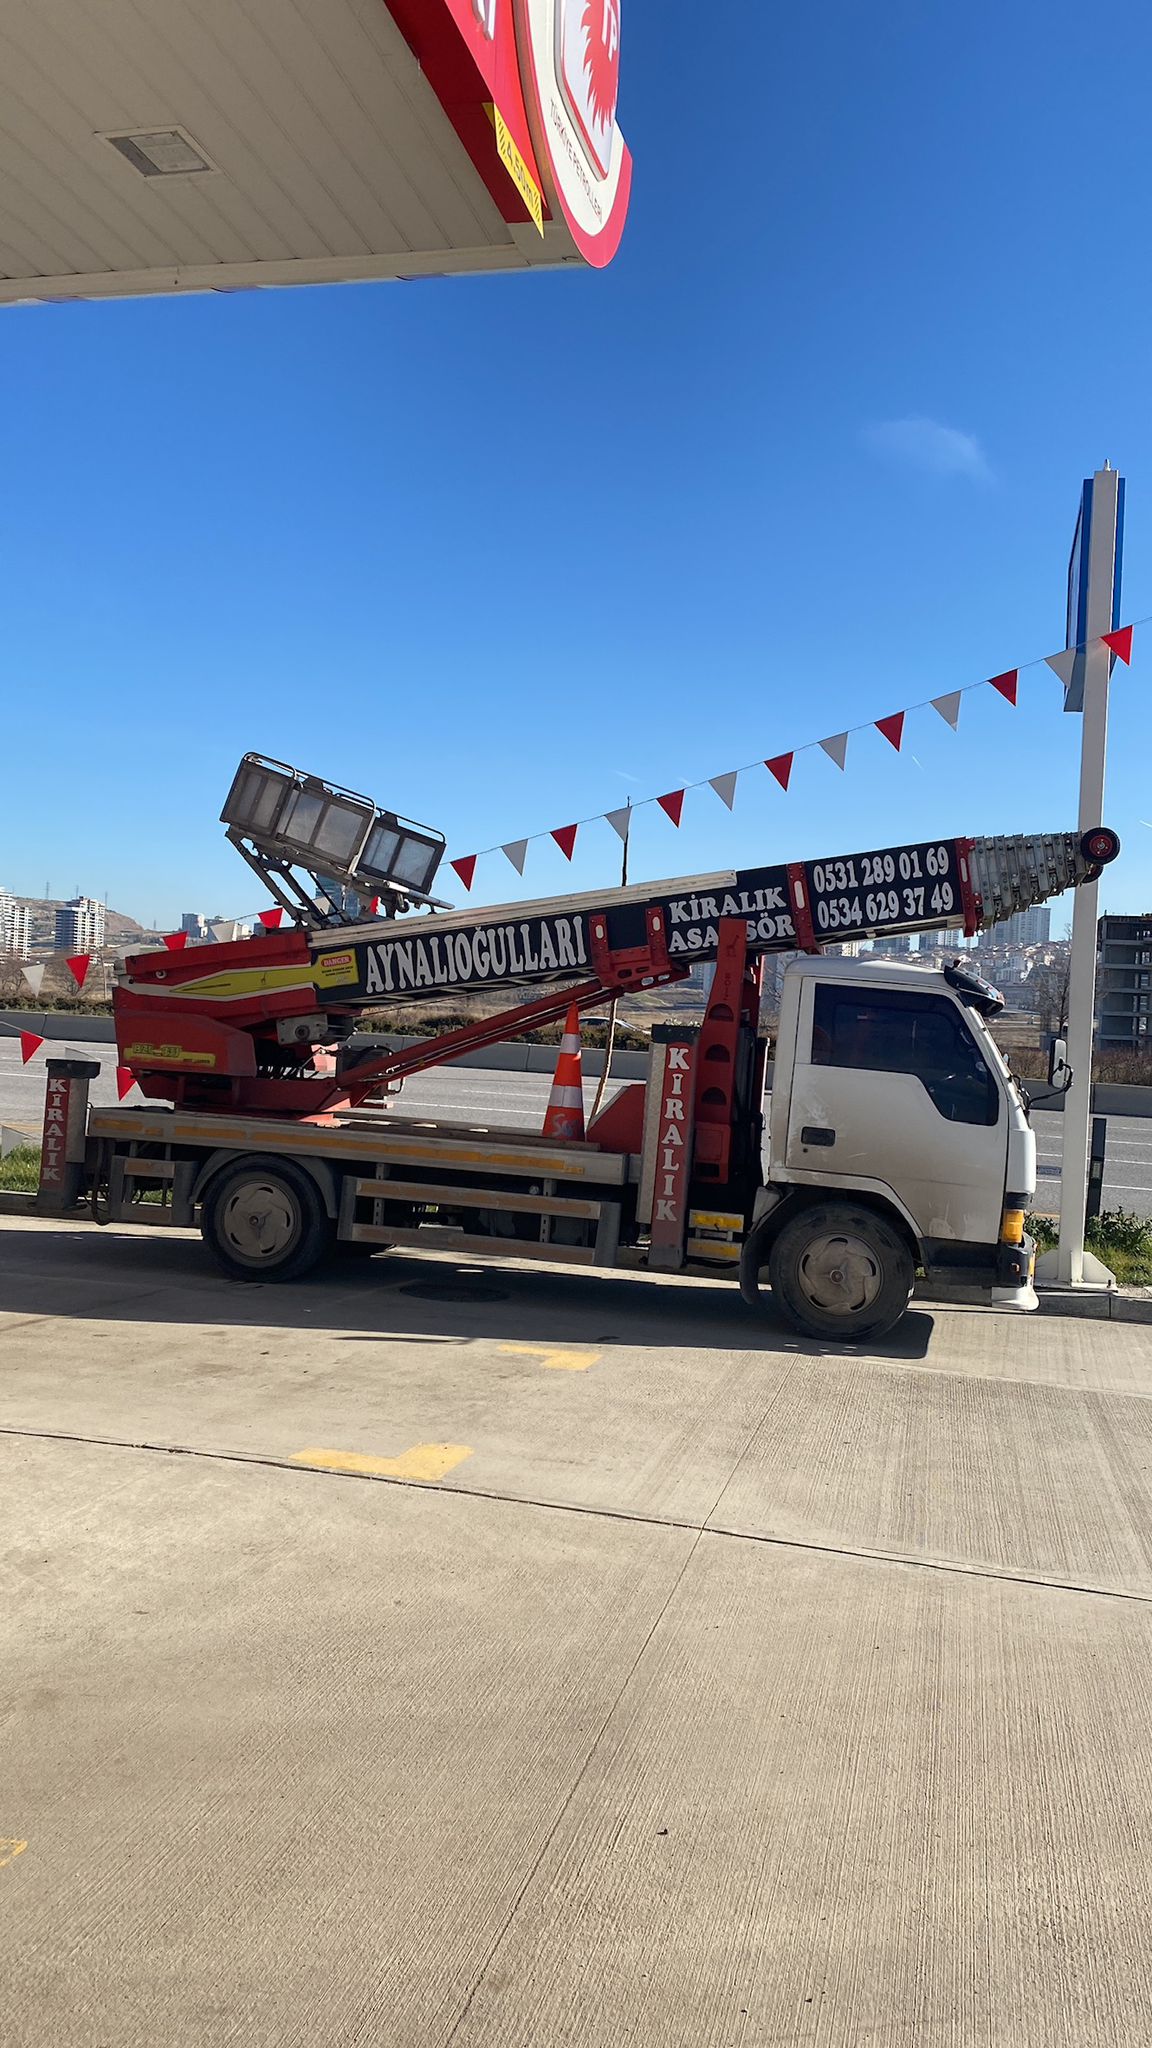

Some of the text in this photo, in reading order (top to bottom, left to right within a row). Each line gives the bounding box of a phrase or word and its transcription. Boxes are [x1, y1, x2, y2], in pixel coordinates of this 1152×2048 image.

[813, 846, 949, 893] 0531 289 01 69
[668, 885, 787, 924] KİRALIK
[816, 881, 954, 929] 0534 629 37 49
[366, 915, 588, 994] AYNALIOĞULLARI
[667, 911, 796, 952] ASASÖR
[323, 956, 351, 967] DANGER
[43, 1079, 67, 1180] KIRALIK
[655, 1047, 690, 1222] KIRALIK
